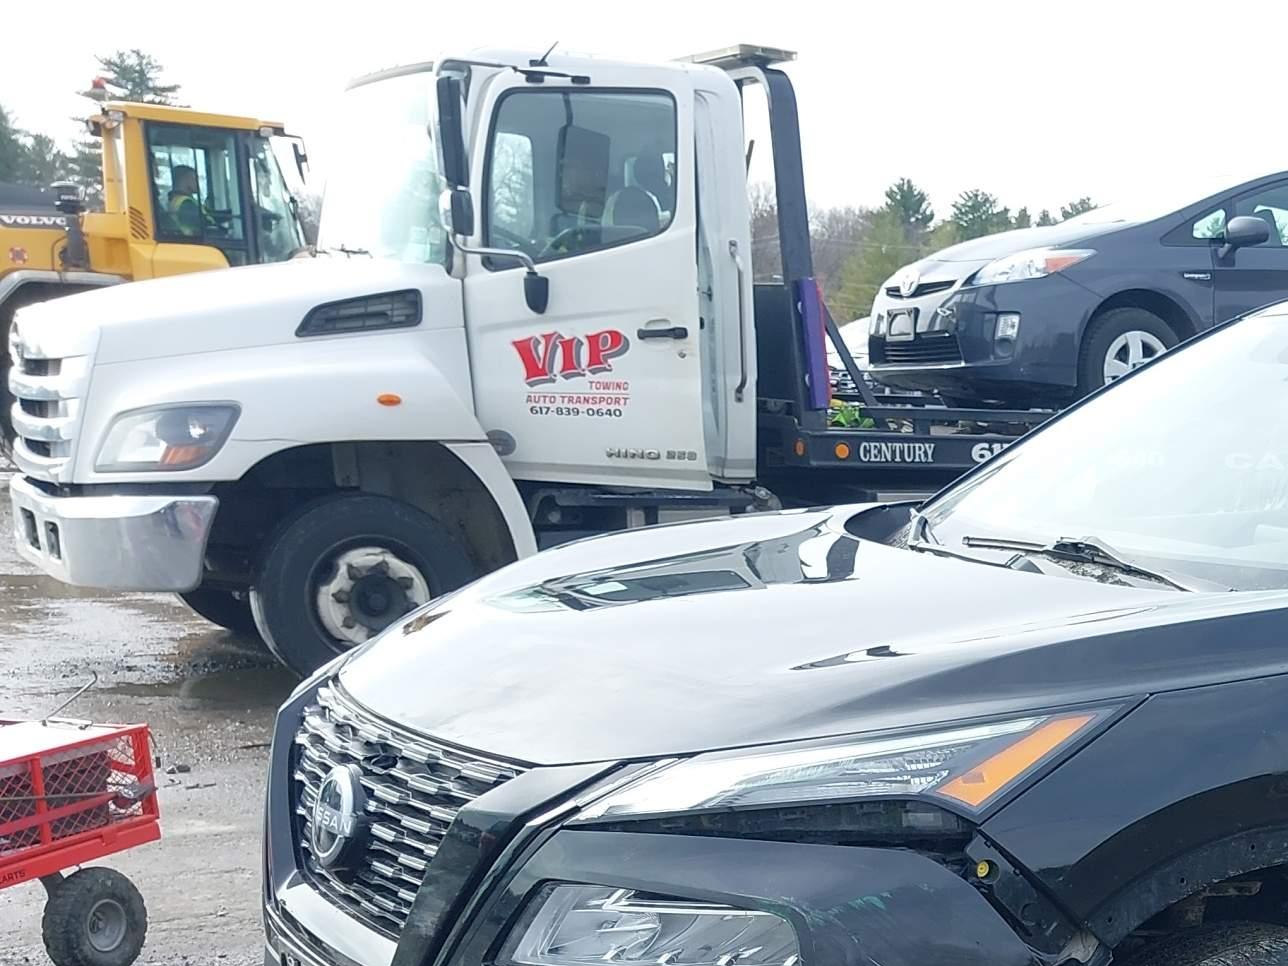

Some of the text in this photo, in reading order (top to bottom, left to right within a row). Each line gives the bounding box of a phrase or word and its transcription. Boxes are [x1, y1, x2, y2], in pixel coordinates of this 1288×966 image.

[0, 215, 67, 225] VOLVO
[588, 380, 630, 391] TOWING
[526, 395, 630, 406] AUTO TRANSPORT
[529, 405, 623, 418] 617-839-0640
[606, 448, 661, 460] HINO
[859, 442, 935, 462] CENTURY
[0, 870, 26, 883] ARTS
